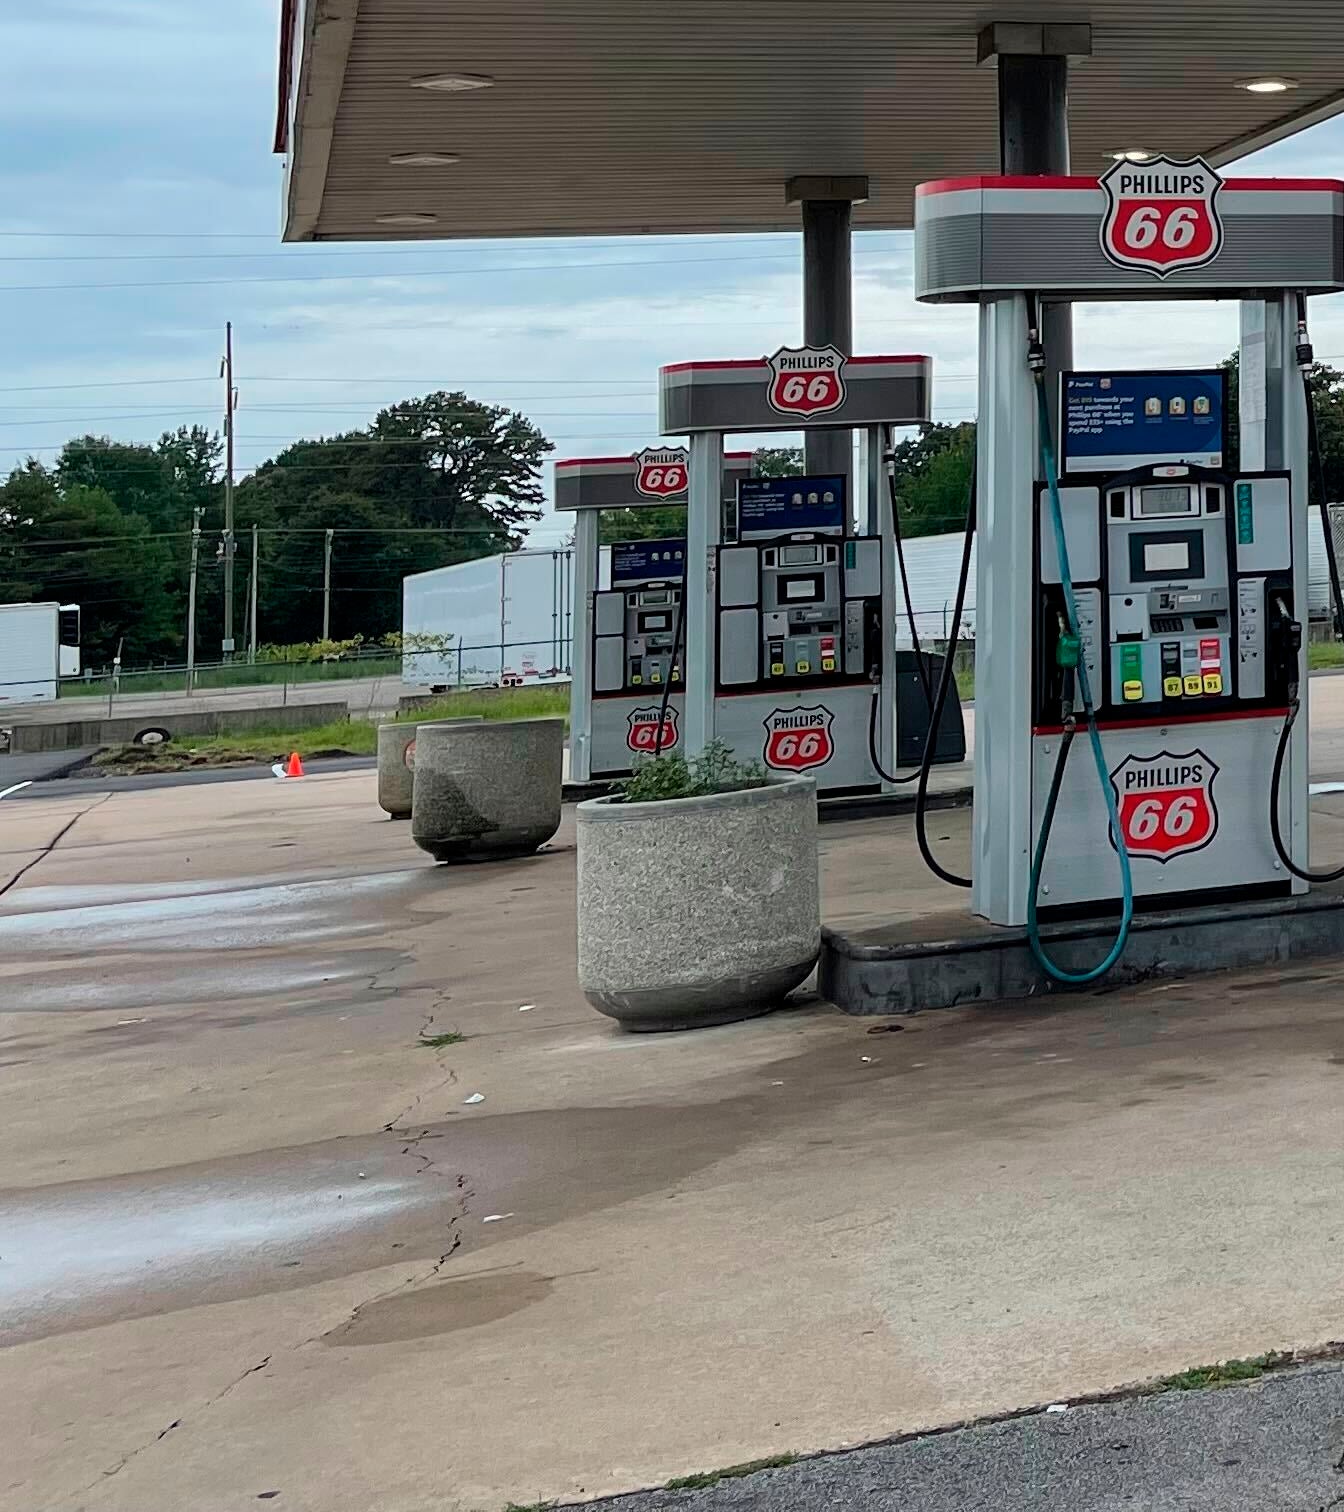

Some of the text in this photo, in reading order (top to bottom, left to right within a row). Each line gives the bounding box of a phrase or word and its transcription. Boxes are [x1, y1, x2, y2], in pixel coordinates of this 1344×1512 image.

[1120, 175, 1204, 194] PHILLIPS
[1124, 206, 1199, 249] 66
[780, 356, 834, 369] PHILLIPS
[782, 375, 832, 403] 66
[644, 453, 685, 464] PHILLIPS
[645, 467, 682, 488] 66
[1167, 683, 1179, 692] 87
[1207, 681, 1218, 689] 91
[635, 711, 672, 723] PHILLIS
[774, 714, 824, 729] PHILLIPS
[776, 732, 822, 760] 66
[1125, 765, 1203, 789] PHILLIPS
[1128, 795, 1198, 840] 66
